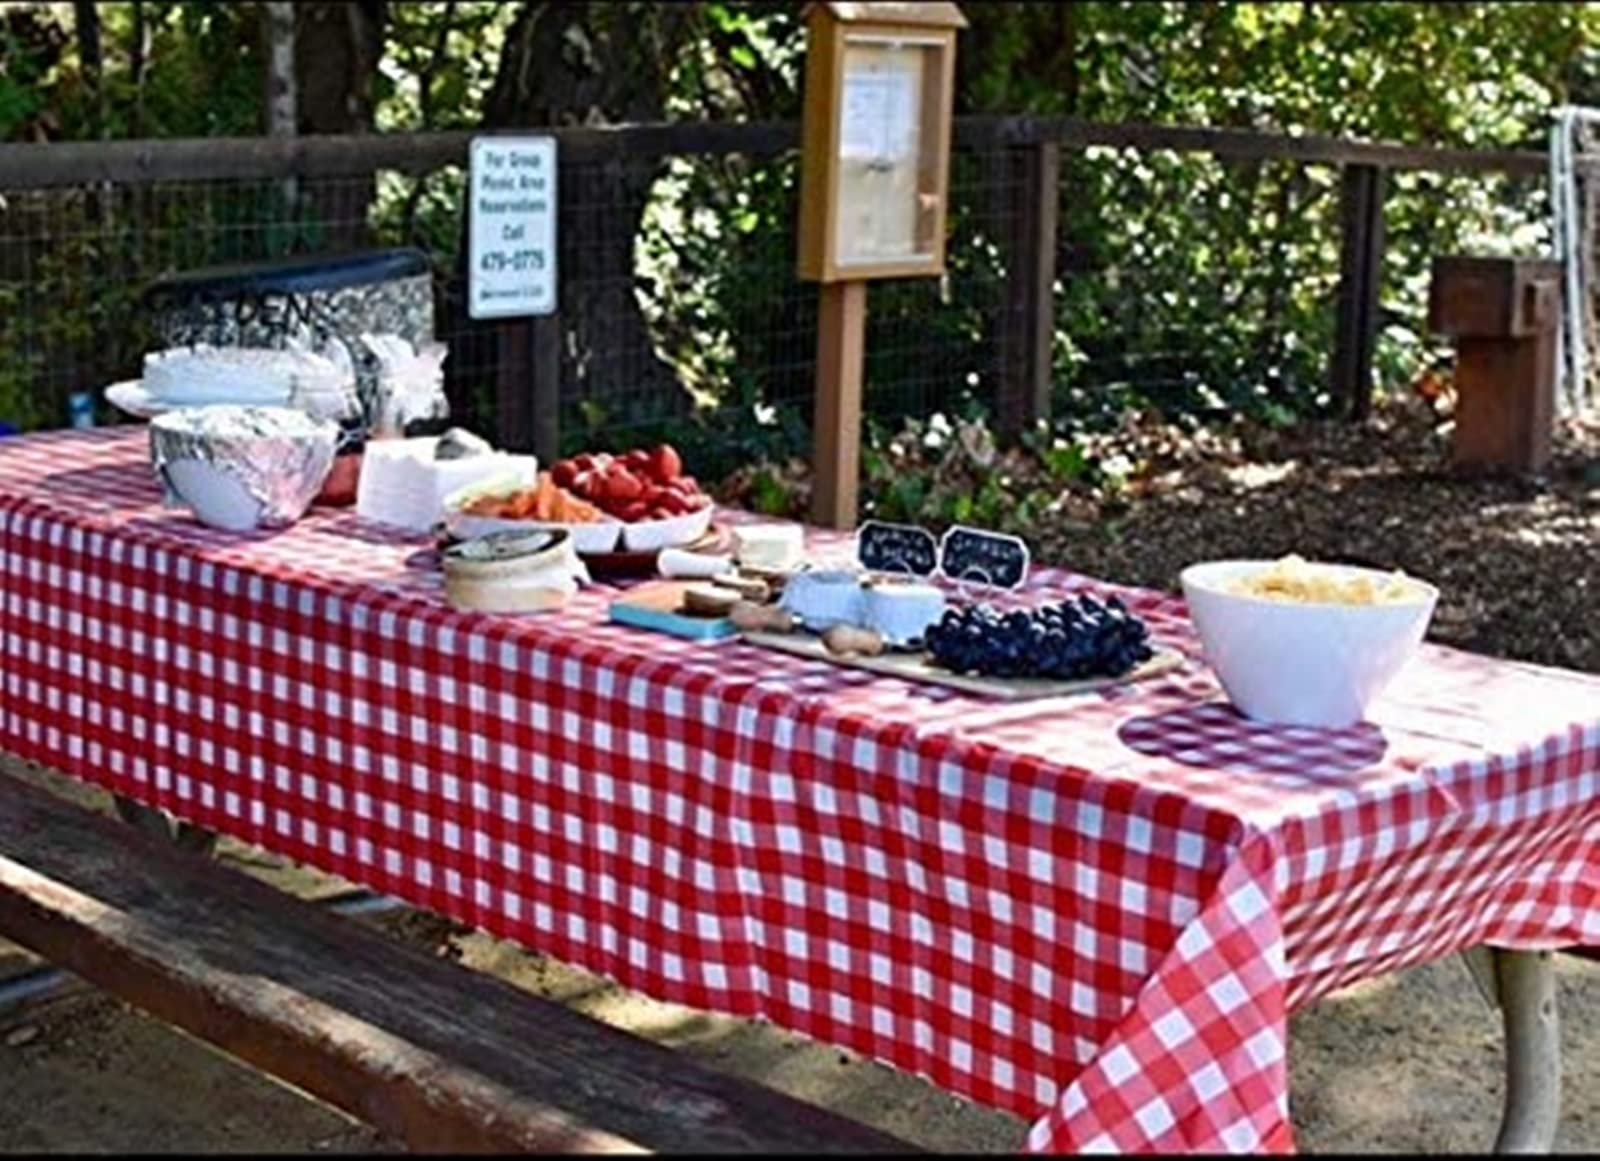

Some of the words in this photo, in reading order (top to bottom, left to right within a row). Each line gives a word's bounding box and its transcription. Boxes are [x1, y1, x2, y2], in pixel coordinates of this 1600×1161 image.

[485, 152, 504, 168] For
[509, 151, 541, 168] Group
[481, 175, 515, 191] Picnic
[519, 175, 546, 191] Area
[479, 198, 547, 214] Reservations
[502, 224, 525, 241] Call
